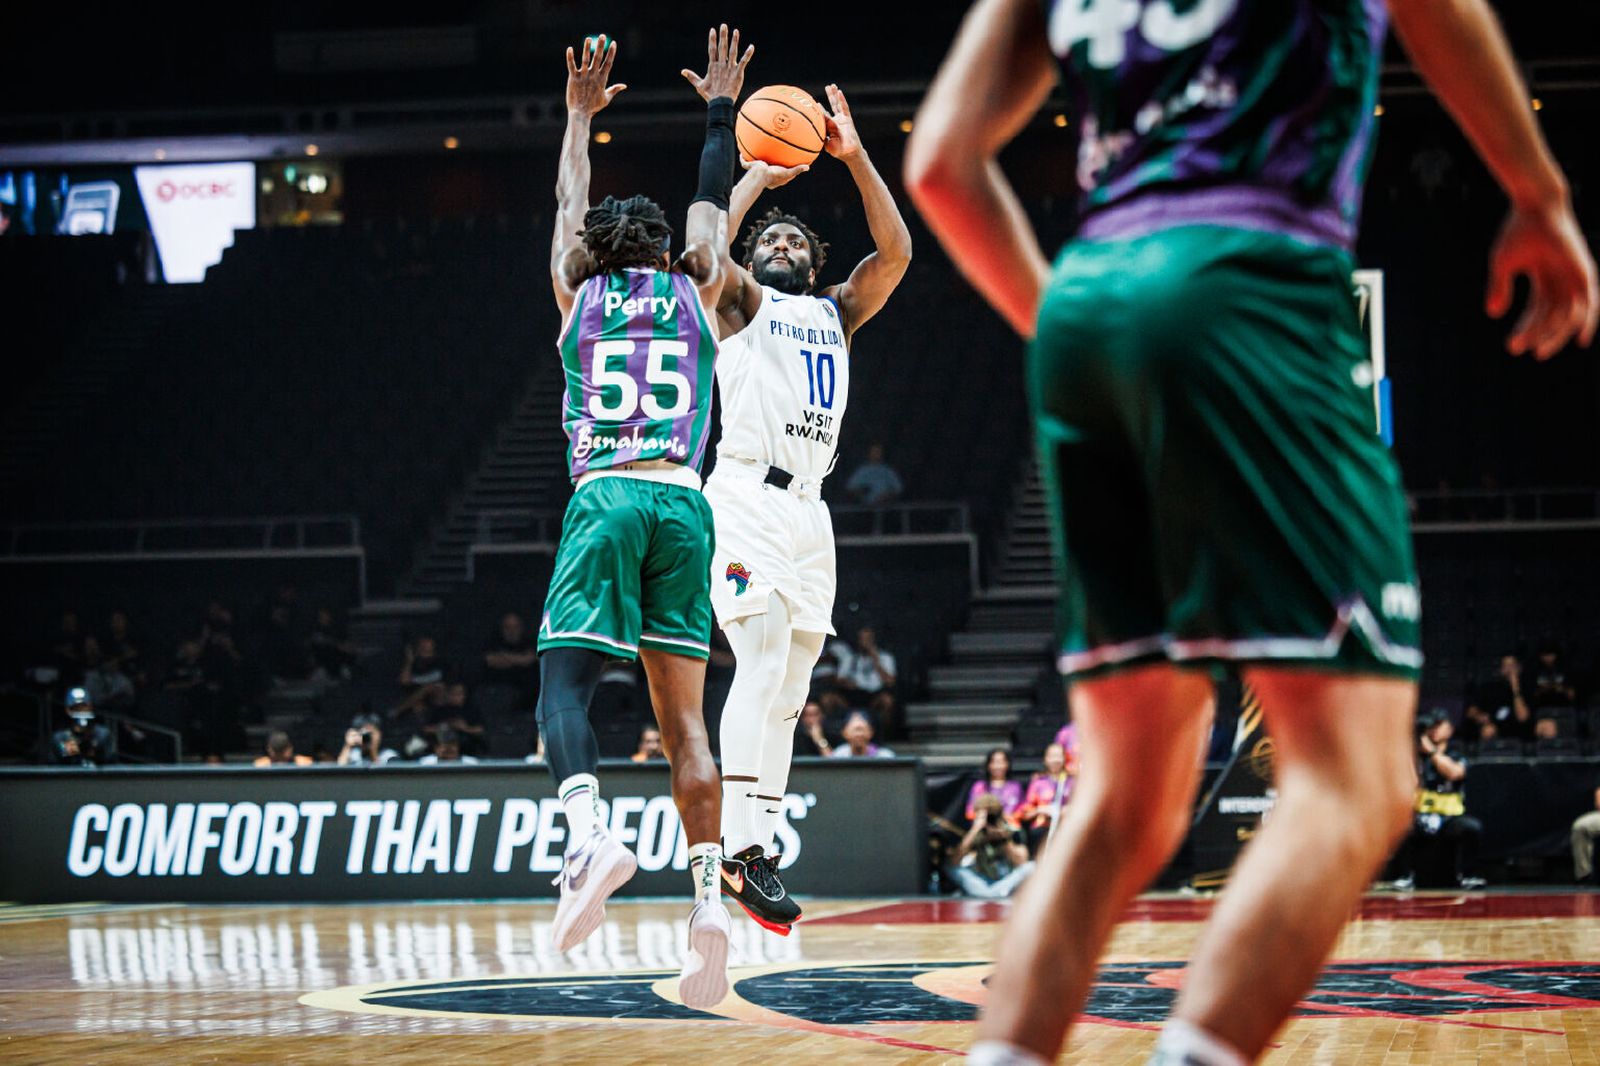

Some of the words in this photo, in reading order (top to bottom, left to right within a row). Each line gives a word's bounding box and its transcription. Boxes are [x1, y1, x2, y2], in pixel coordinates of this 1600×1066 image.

[605, 291, 677, 321] Perry
[770, 320, 805, 341] PETRO
[808, 328, 819, 345] DE
[588, 340, 691, 421] 55
[800, 349, 835, 410] 10
[803, 410, 833, 430] VISIT
[67, 802, 337, 877] COMFORT
[346, 800, 491, 874] THAT
